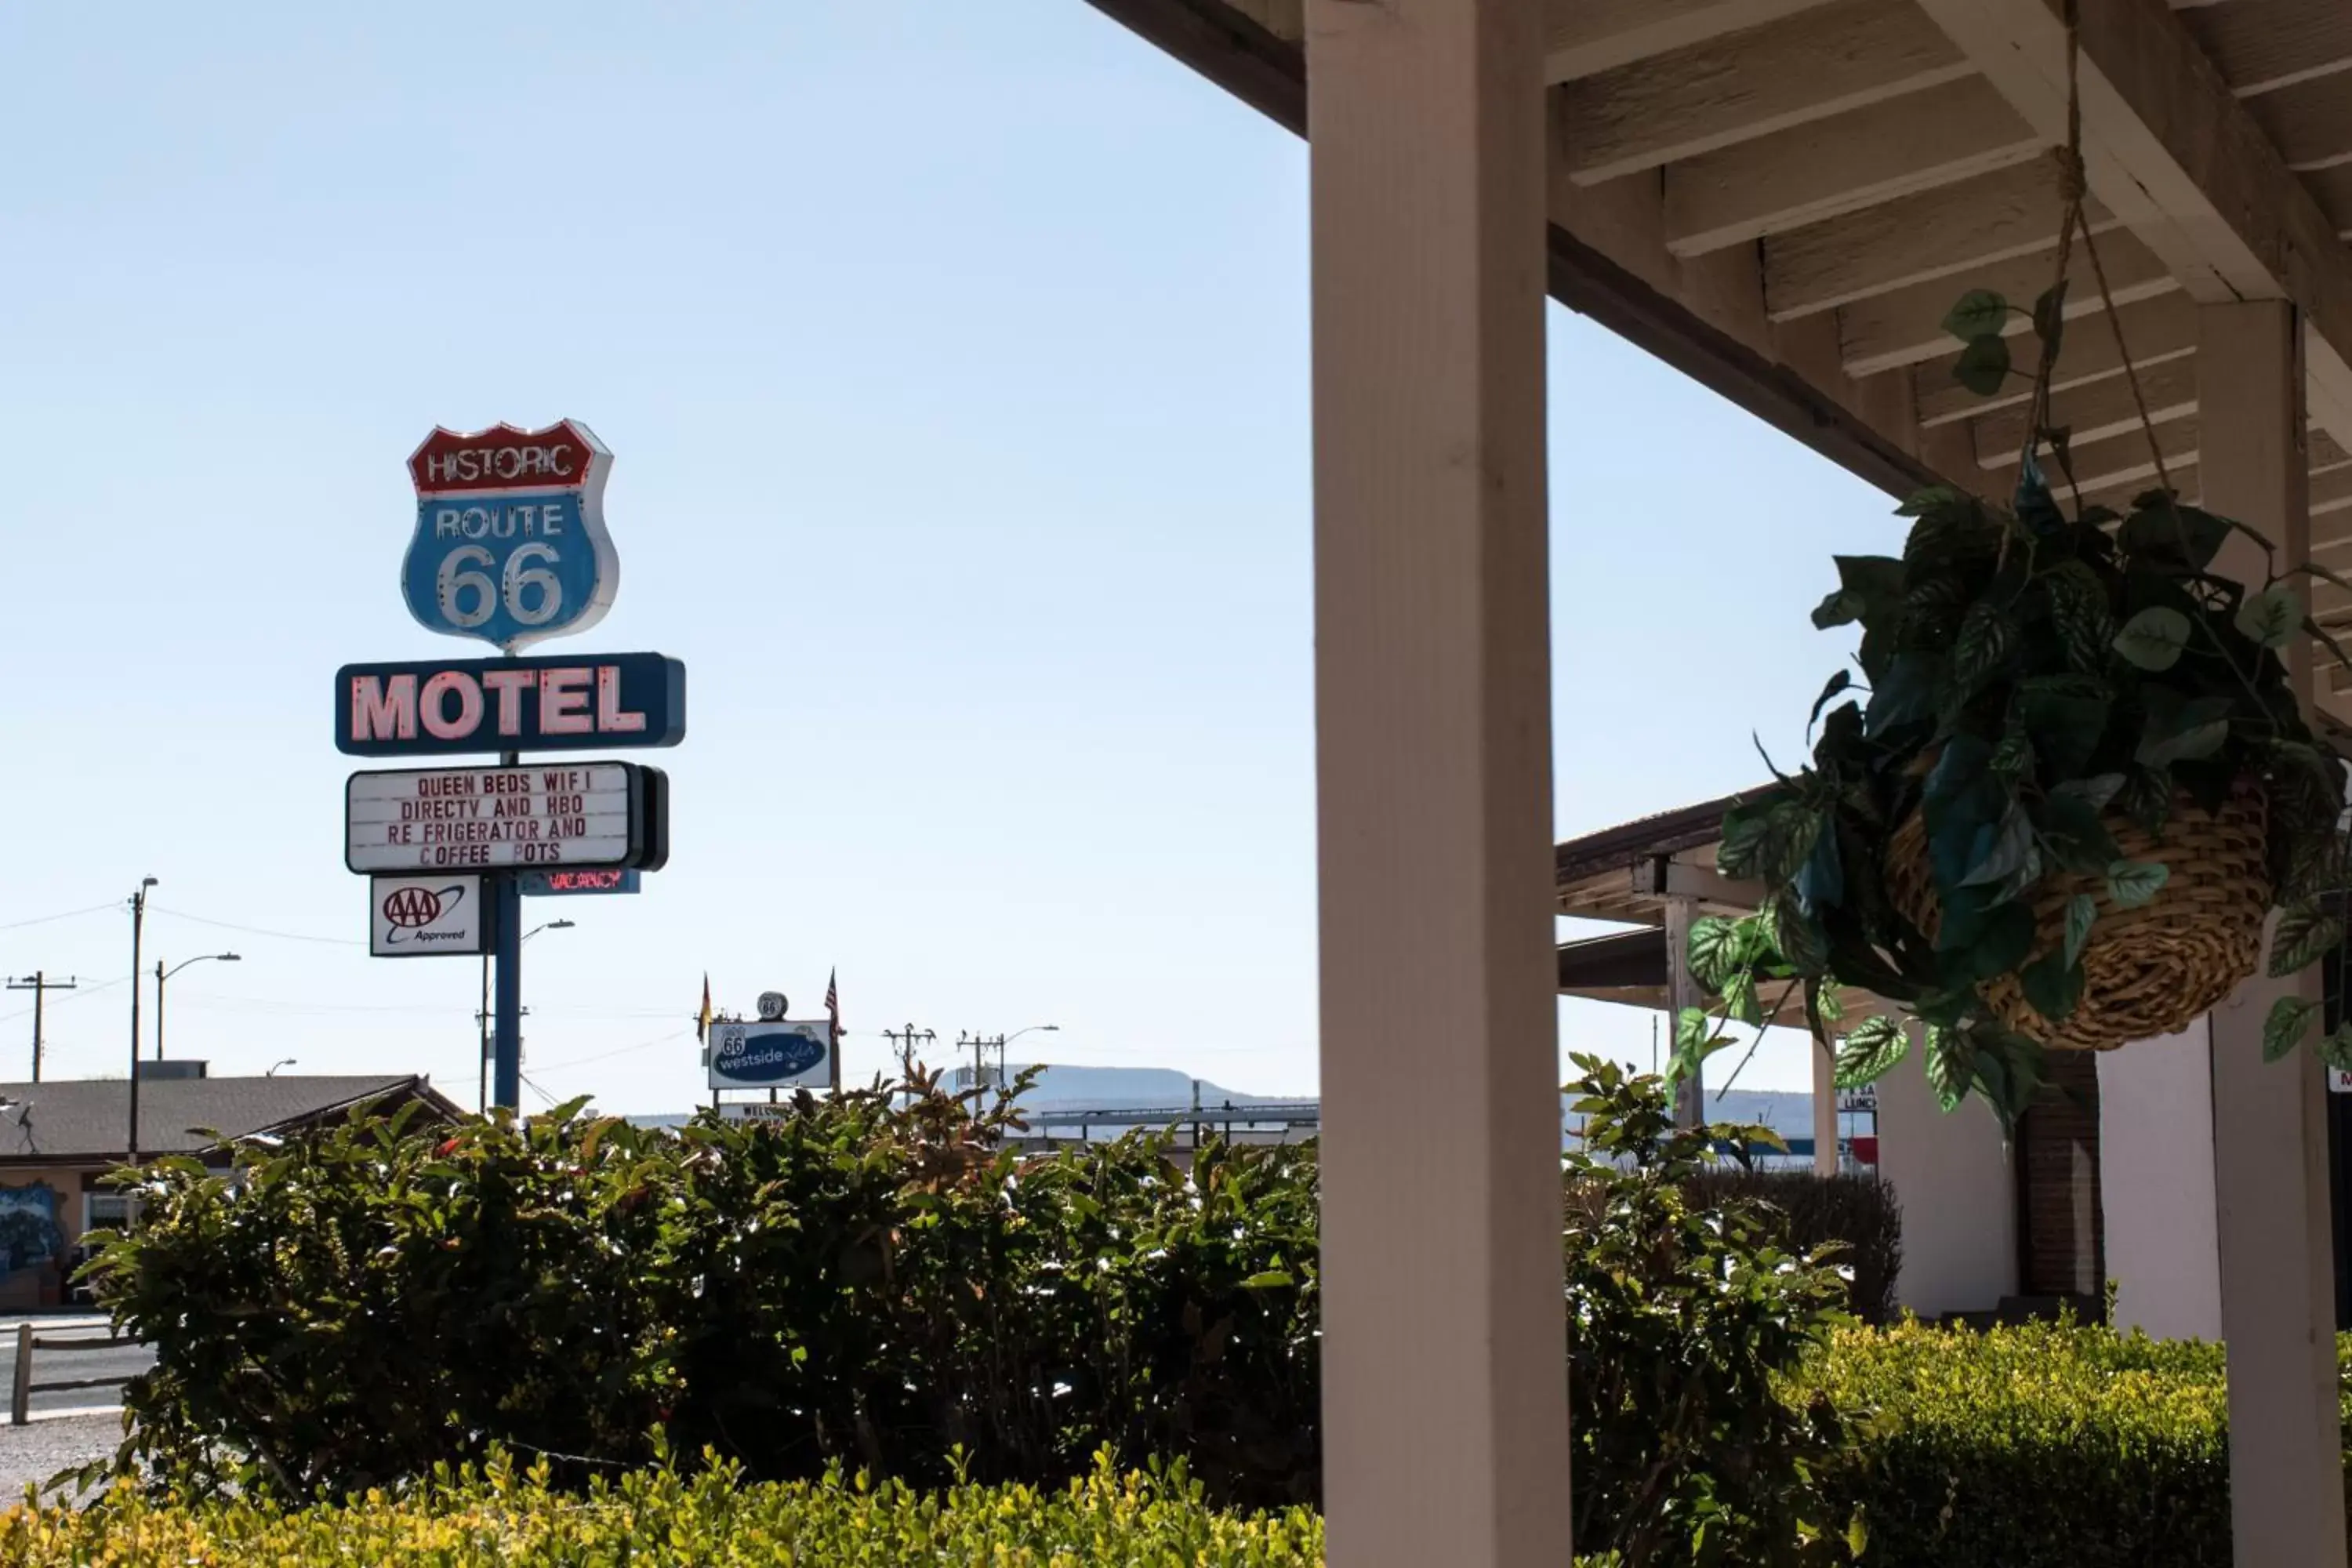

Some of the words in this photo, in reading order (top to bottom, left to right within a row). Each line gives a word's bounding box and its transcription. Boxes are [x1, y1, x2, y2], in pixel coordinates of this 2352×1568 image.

[427, 445, 572, 483] HISTORIC
[436, 504, 563, 540] ROUTE
[436, 541, 563, 628] 66
[351, 665, 647, 741] MOTEL
[418, 775, 475, 797] QUEEN
[483, 774, 531, 795] BEDS
[401, 798, 480, 820] DIRECTV
[493, 797, 531, 818] AND
[546, 794, 583, 815] HBO
[548, 818, 586, 838] AND
[419, 844, 490, 865] COFFEE
[514, 843, 561, 862] POTS
[550, 869, 621, 890] VACANCY
[390, 887, 436, 927] AAA
[414, 929, 466, 944] Approved
[724, 1037, 743, 1054] 66
[720, 1047, 783, 1070] westside
